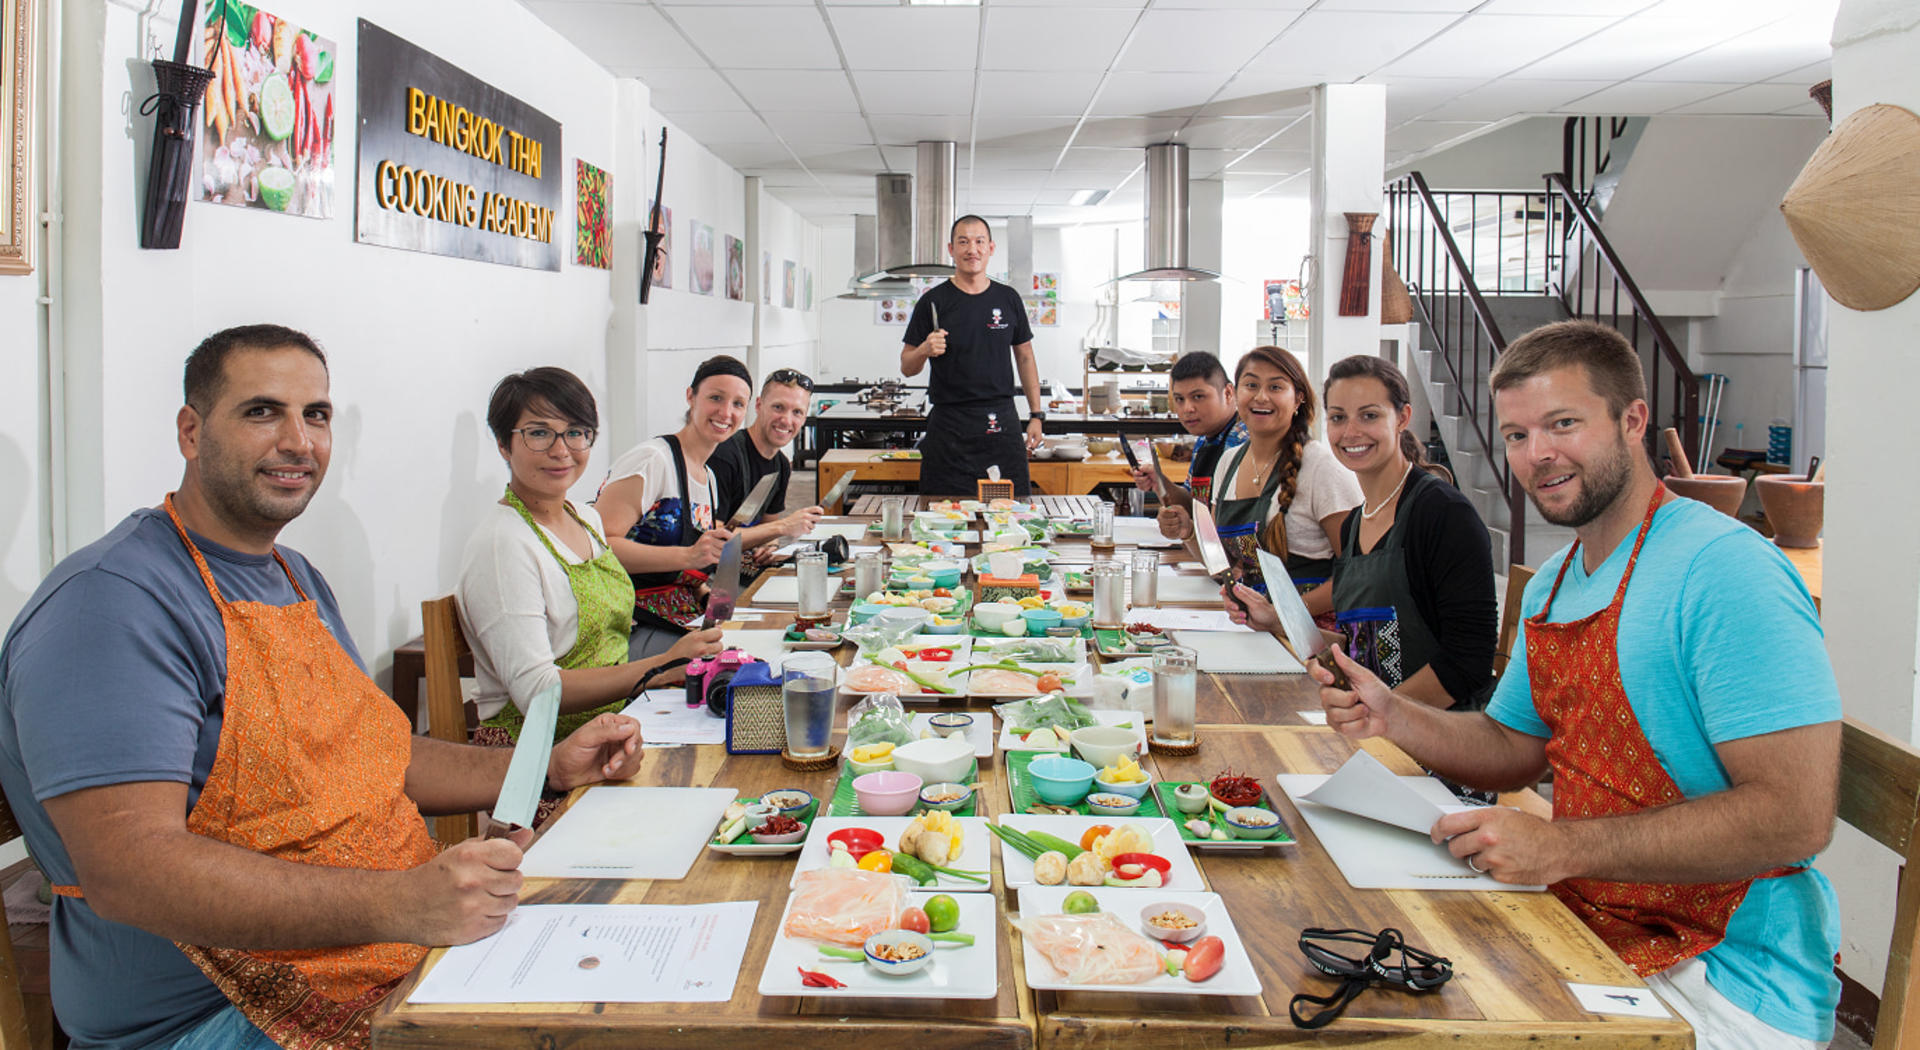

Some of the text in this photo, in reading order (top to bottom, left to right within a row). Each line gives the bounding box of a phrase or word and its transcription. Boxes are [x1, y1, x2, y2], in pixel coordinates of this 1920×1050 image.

[407, 87, 542, 179] BANGKOK THAI
[377, 160, 556, 243] COOKING ACADEMY
